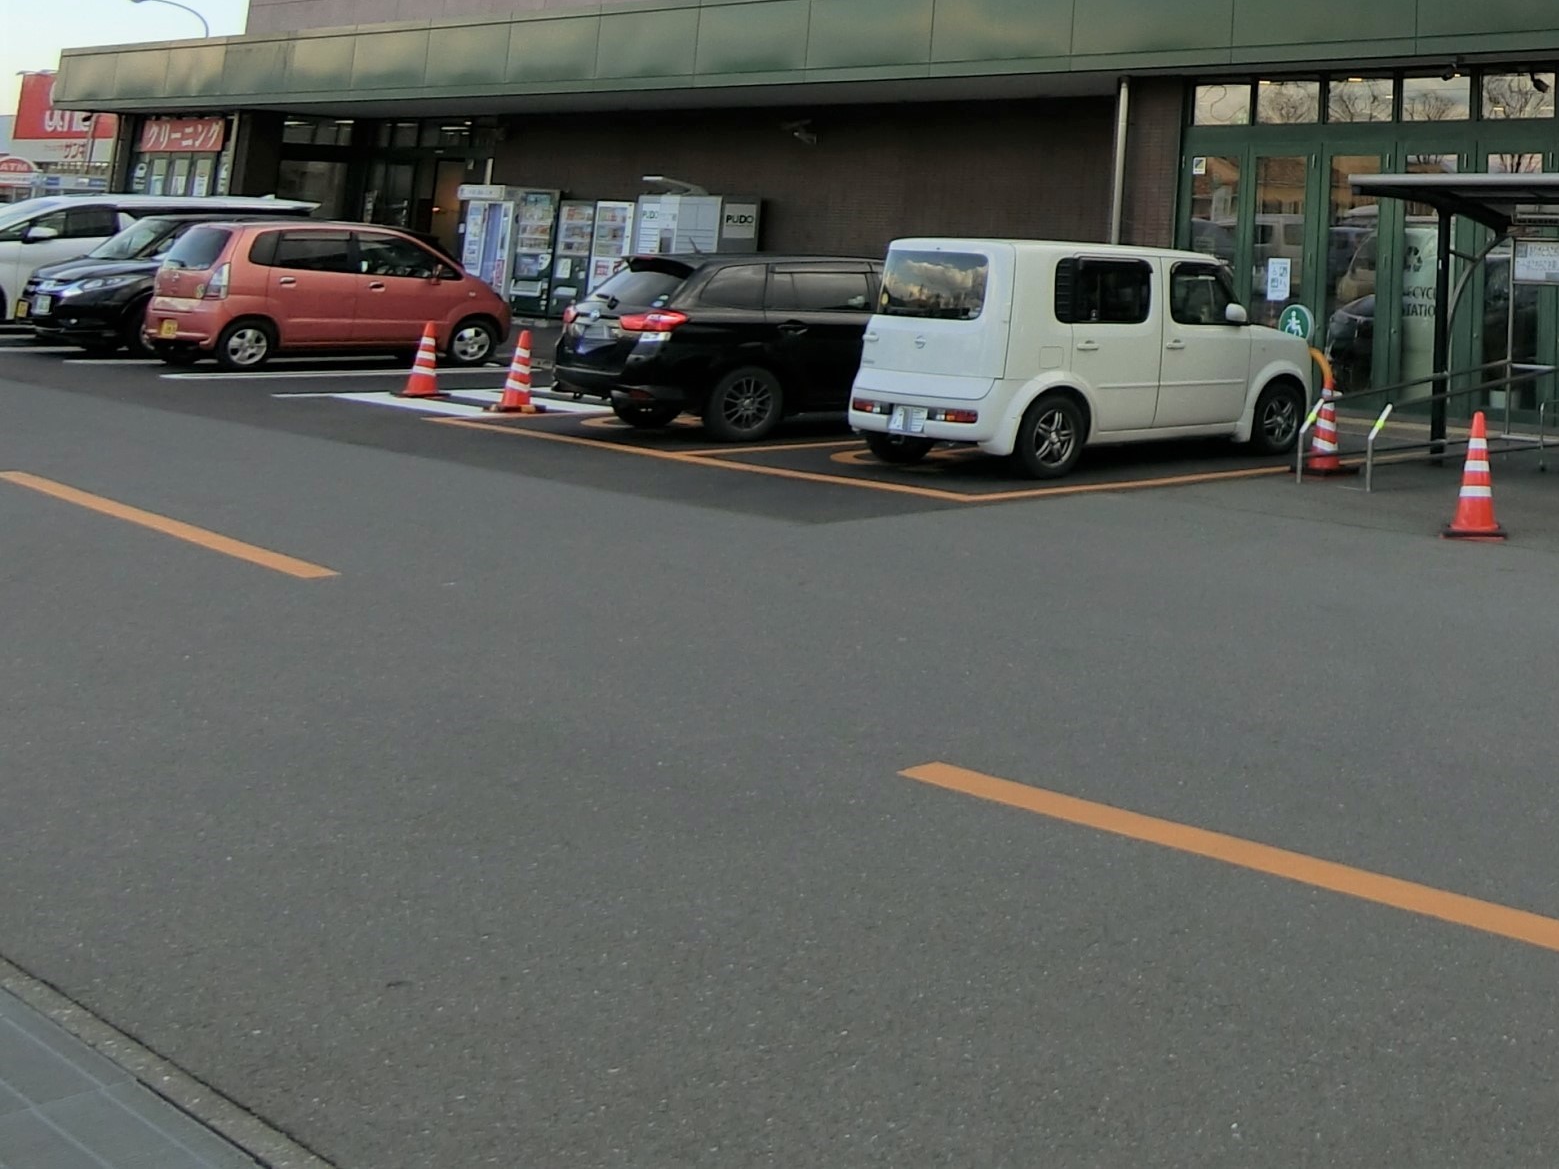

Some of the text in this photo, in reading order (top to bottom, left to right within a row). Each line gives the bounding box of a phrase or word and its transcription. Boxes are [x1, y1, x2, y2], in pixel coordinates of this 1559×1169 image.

[146, 121, 222, 149] クリーニング
[726, 215, 754, 224] PUDO
